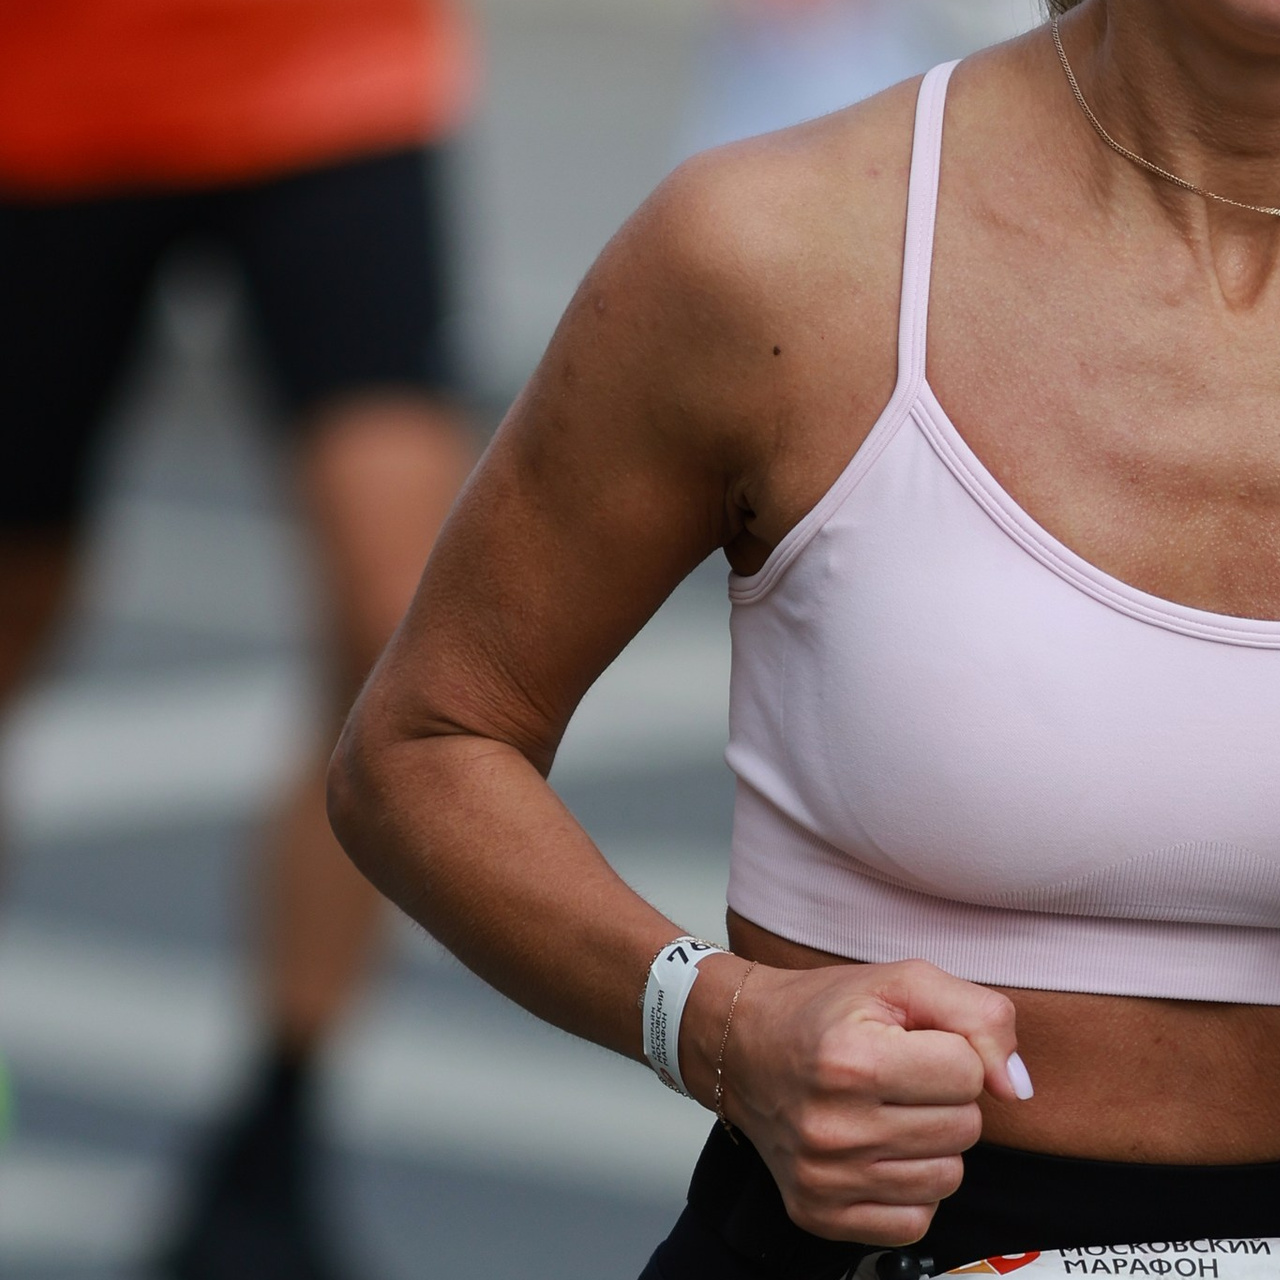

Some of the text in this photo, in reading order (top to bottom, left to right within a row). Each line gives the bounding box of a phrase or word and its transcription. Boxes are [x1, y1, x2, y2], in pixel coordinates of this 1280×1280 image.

[654, 989, 665, 1064] МОСКОВСКИЙ
[659, 1012, 669, 1067] МАРАФОН
[1059, 1238, 1271, 1258] МОСКОВСКИЙ
[1063, 1257, 1219, 1279] МАРАФОН
